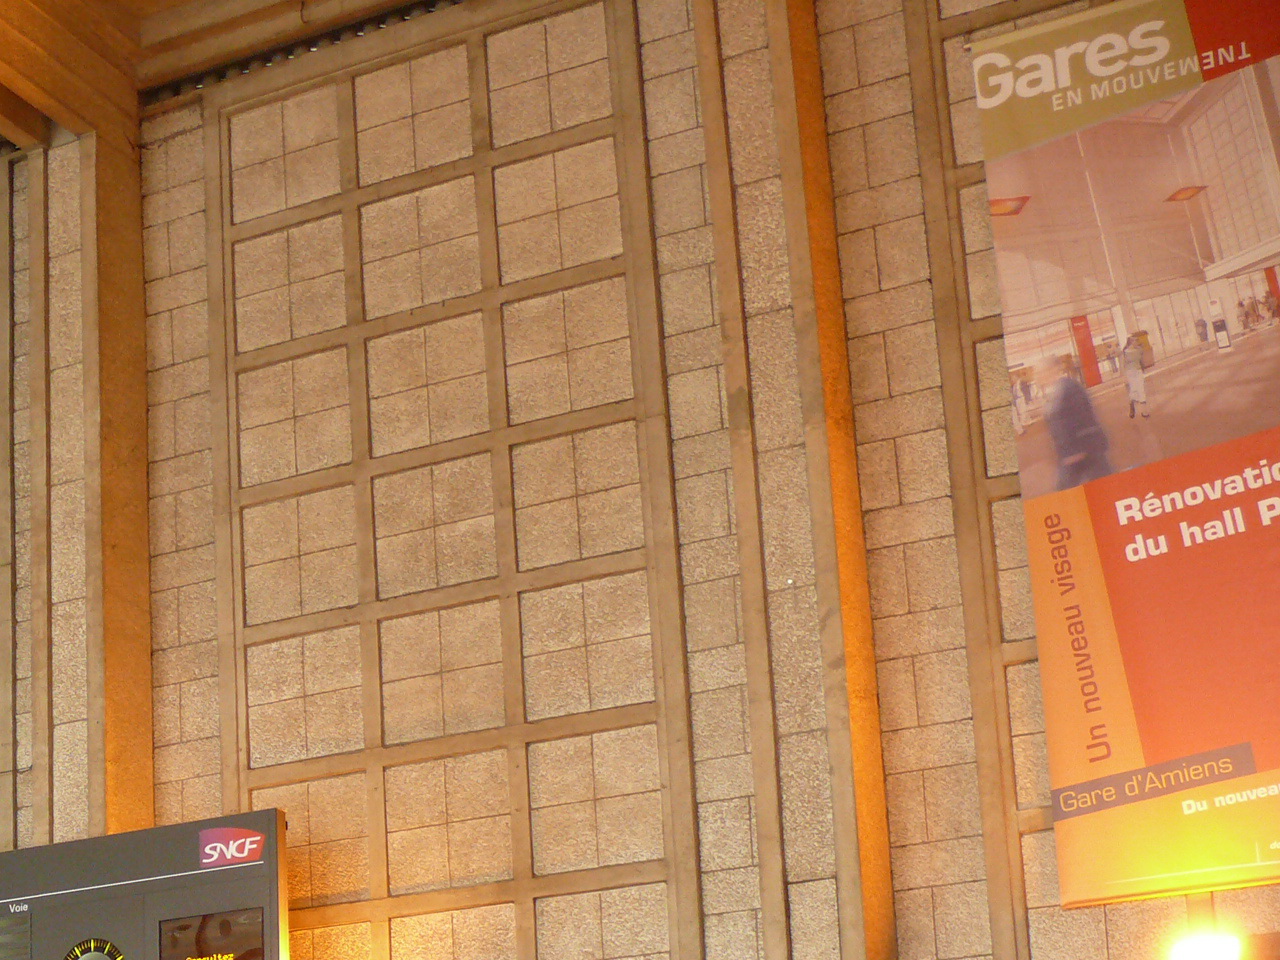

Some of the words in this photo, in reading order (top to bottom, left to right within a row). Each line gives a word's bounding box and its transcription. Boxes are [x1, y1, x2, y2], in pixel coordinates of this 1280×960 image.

[972, 20, 1171, 110] Gares
[1052, 88, 1083, 111] EN
[1044, 513, 1076, 596] visage
[1125, 534, 1168, 562] du
[1179, 506, 1246, 547] hall
[1063, 604, 1102, 713] nouveau
[1086, 723, 1111, 763] Un
[1060, 786, 1116, 812] Gare
[1125, 758, 1233, 796] d'Amiens
[1182, 799, 1208, 815] Du
[202, 836, 261, 863] SNCF
[9, 903, 29, 913] Voie
